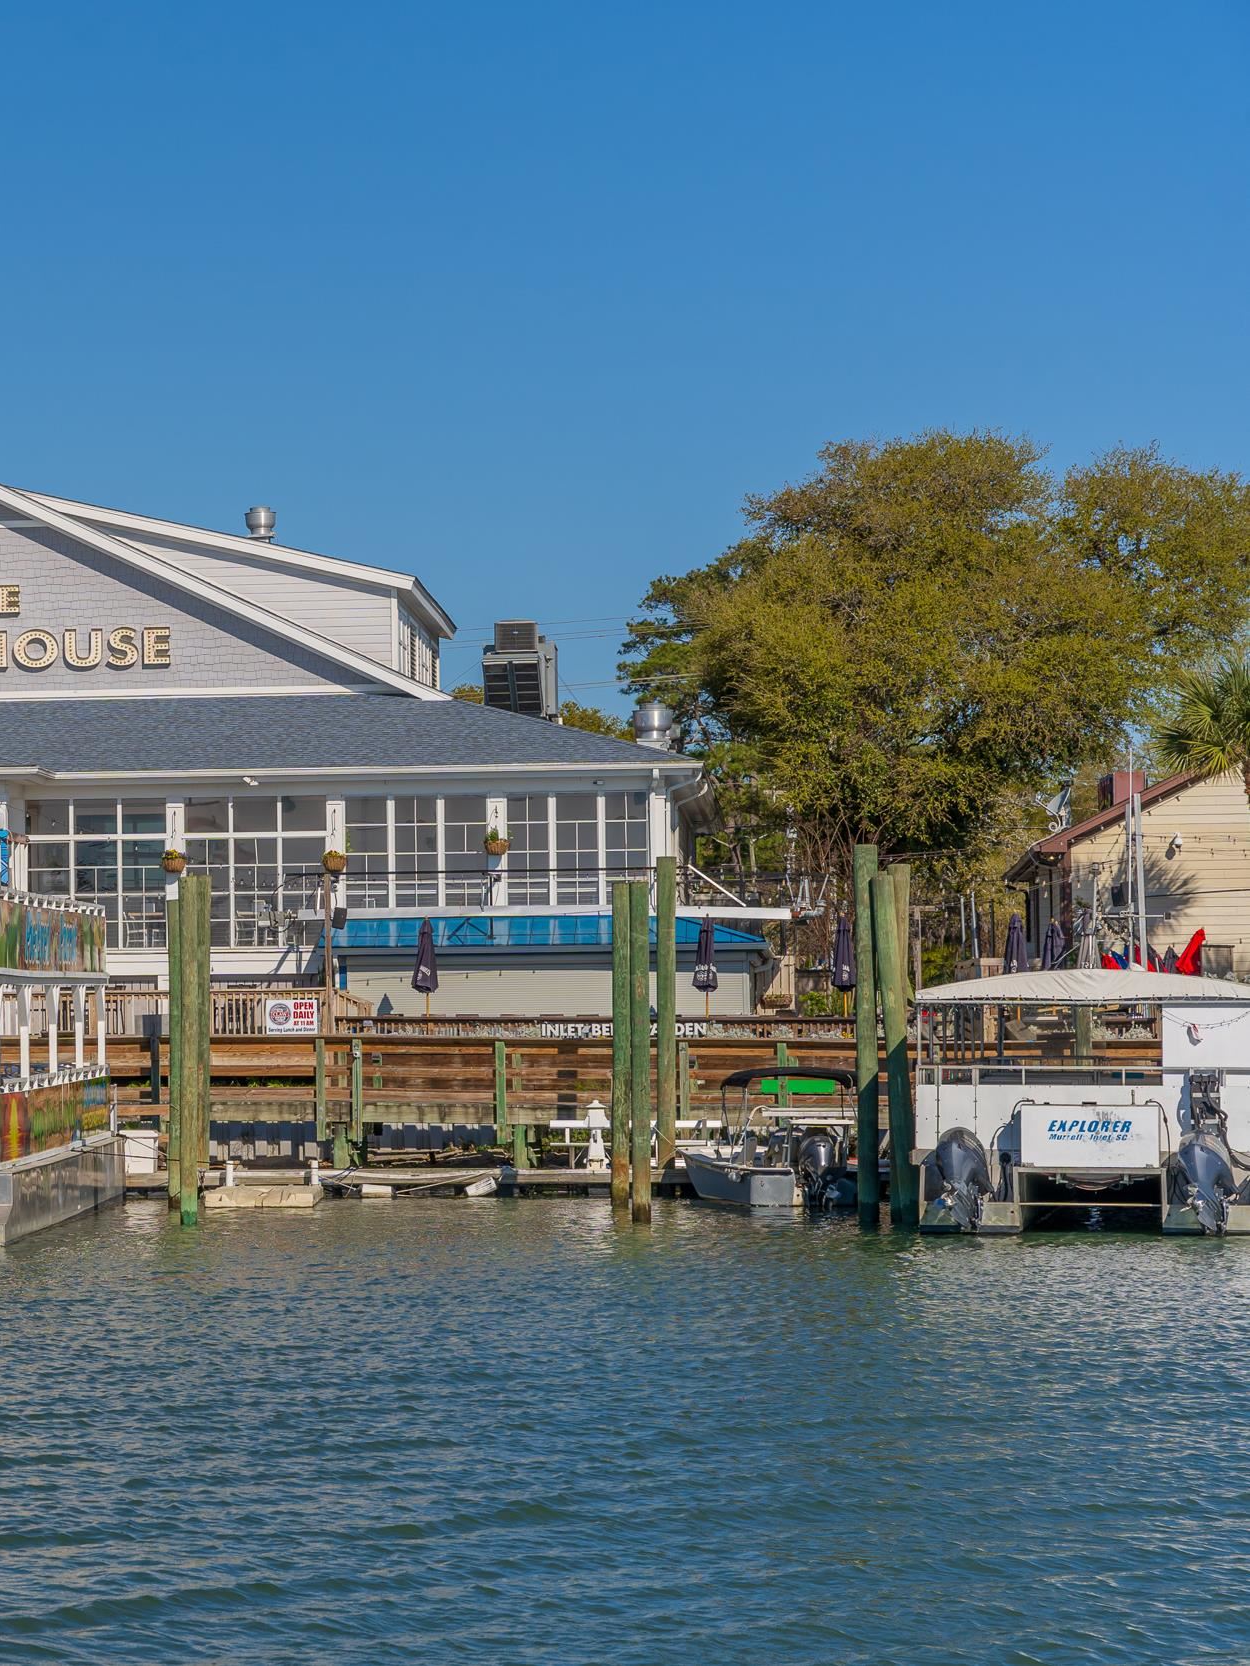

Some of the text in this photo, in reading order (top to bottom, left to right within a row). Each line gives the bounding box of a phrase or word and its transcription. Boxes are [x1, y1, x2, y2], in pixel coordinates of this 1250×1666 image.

[293, 1002, 314, 1010] OPEN
[293, 1011, 314, 1019] DAILY
[541, 1022, 584, 1037] INLET
[1047, 1119, 1133, 1133] EXPLORER
